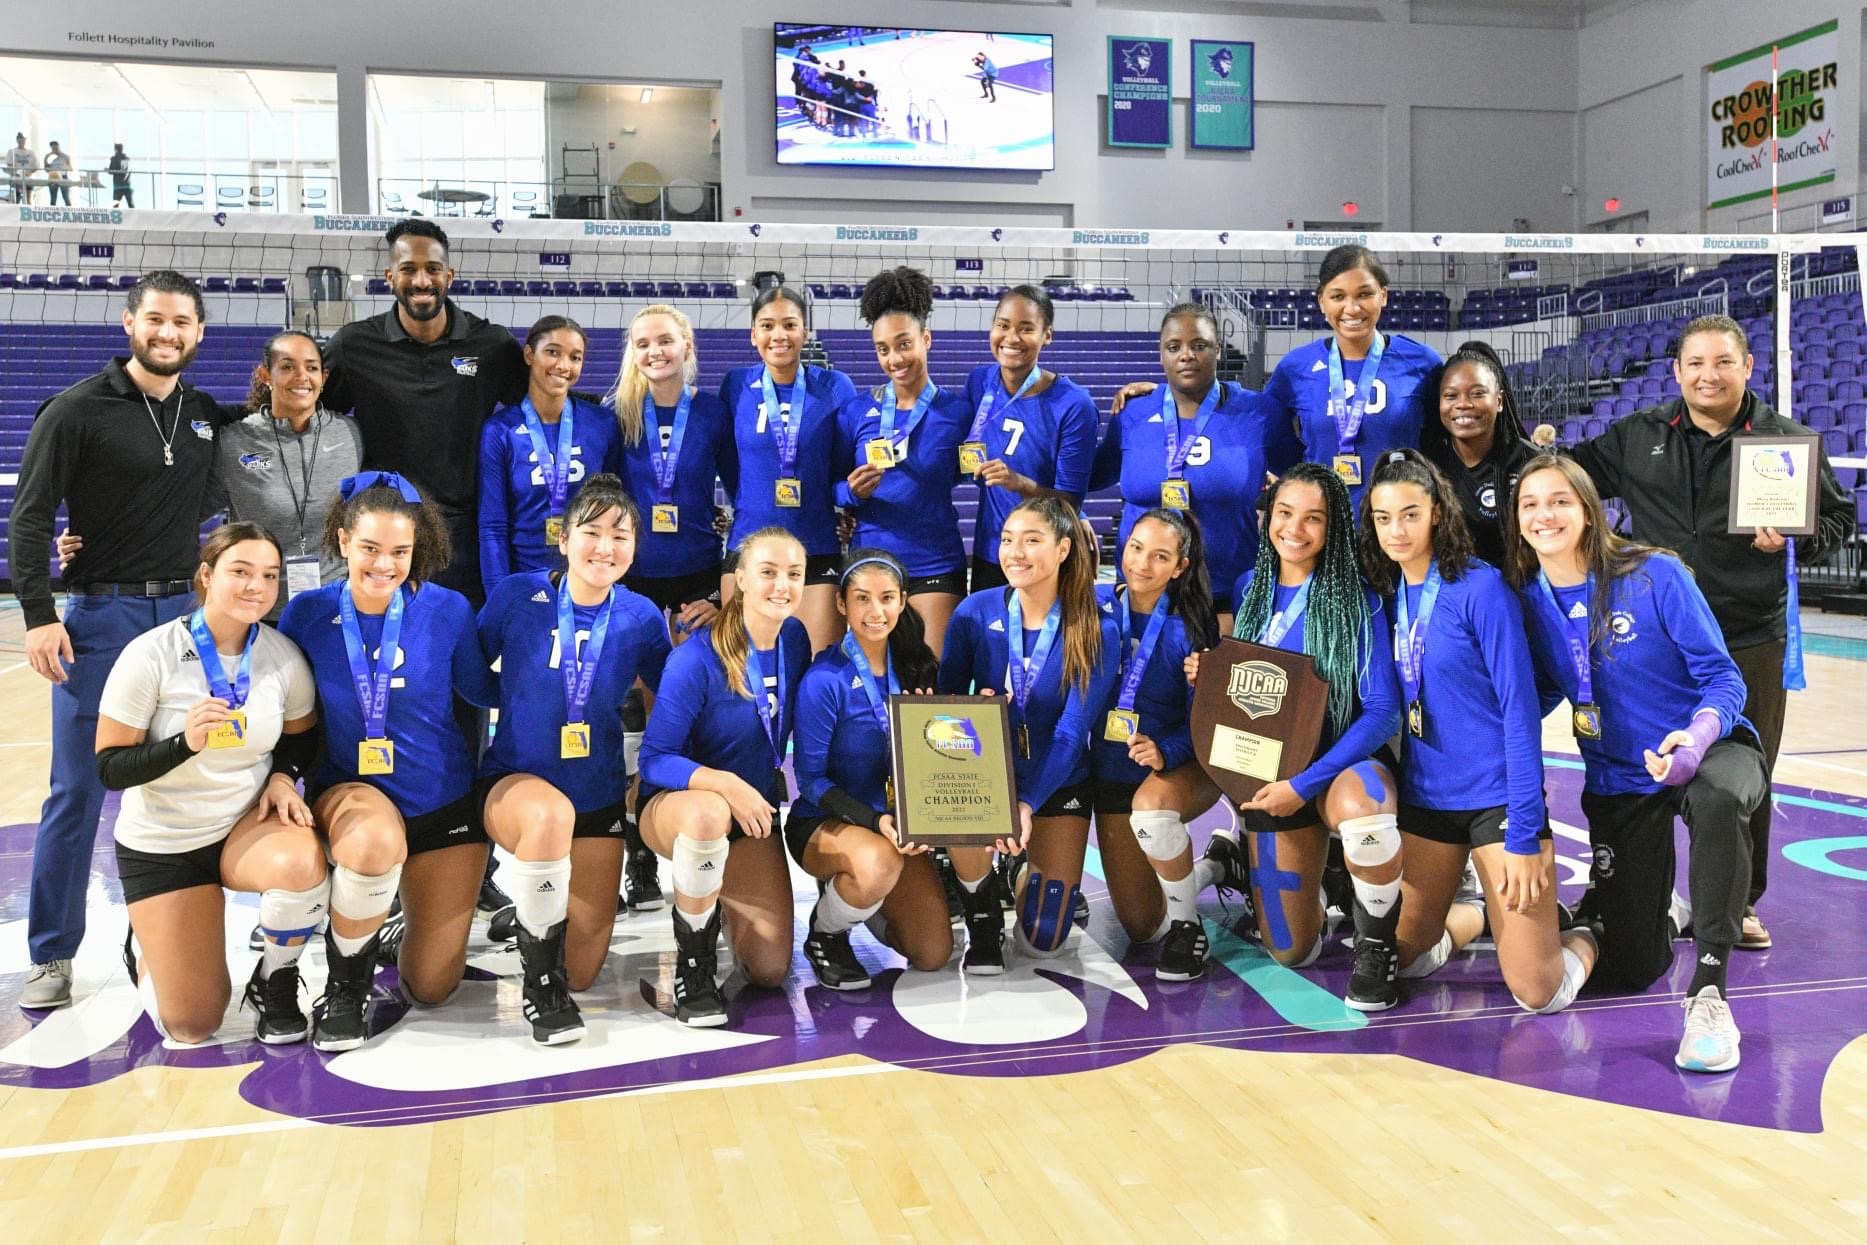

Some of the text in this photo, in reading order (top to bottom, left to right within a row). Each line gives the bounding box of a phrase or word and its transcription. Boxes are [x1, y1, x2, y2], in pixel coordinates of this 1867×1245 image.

[68, 32, 215, 48] Follett Hospitality Pavilion
[1113, 83, 1168, 92] CONFERENCE
[1711, 62, 1838, 121] CROWTHER
[1113, 91, 1169, 100] CHAMPIONS
[1114, 100, 1131, 110] 2020
[1196, 104, 1222, 113] 2020
[1721, 98, 1824, 150] ROOFING
[20, 206, 123, 224] BUCCANEERS
[584, 221, 672, 237] BUCCANEERS
[836, 226, 918, 241] BUCCANEERS
[1072, 230, 1150, 245] BUCCANEERS
[1504, 236, 1573, 249] BUCCANEERS
[1703, 237, 1769, 249] BUCCANEERS
[92, 247, 108, 256] 111
[550, 255, 565, 264] 112
[965, 260, 979, 270] 113
[1002, 418, 1025, 456] 7
[528, 446, 585, 485] 25
[1229, 666, 1286, 694] NJCAA
[371, 672, 389, 719] FCSAA
[924, 796, 992, 805] CHAMPION
